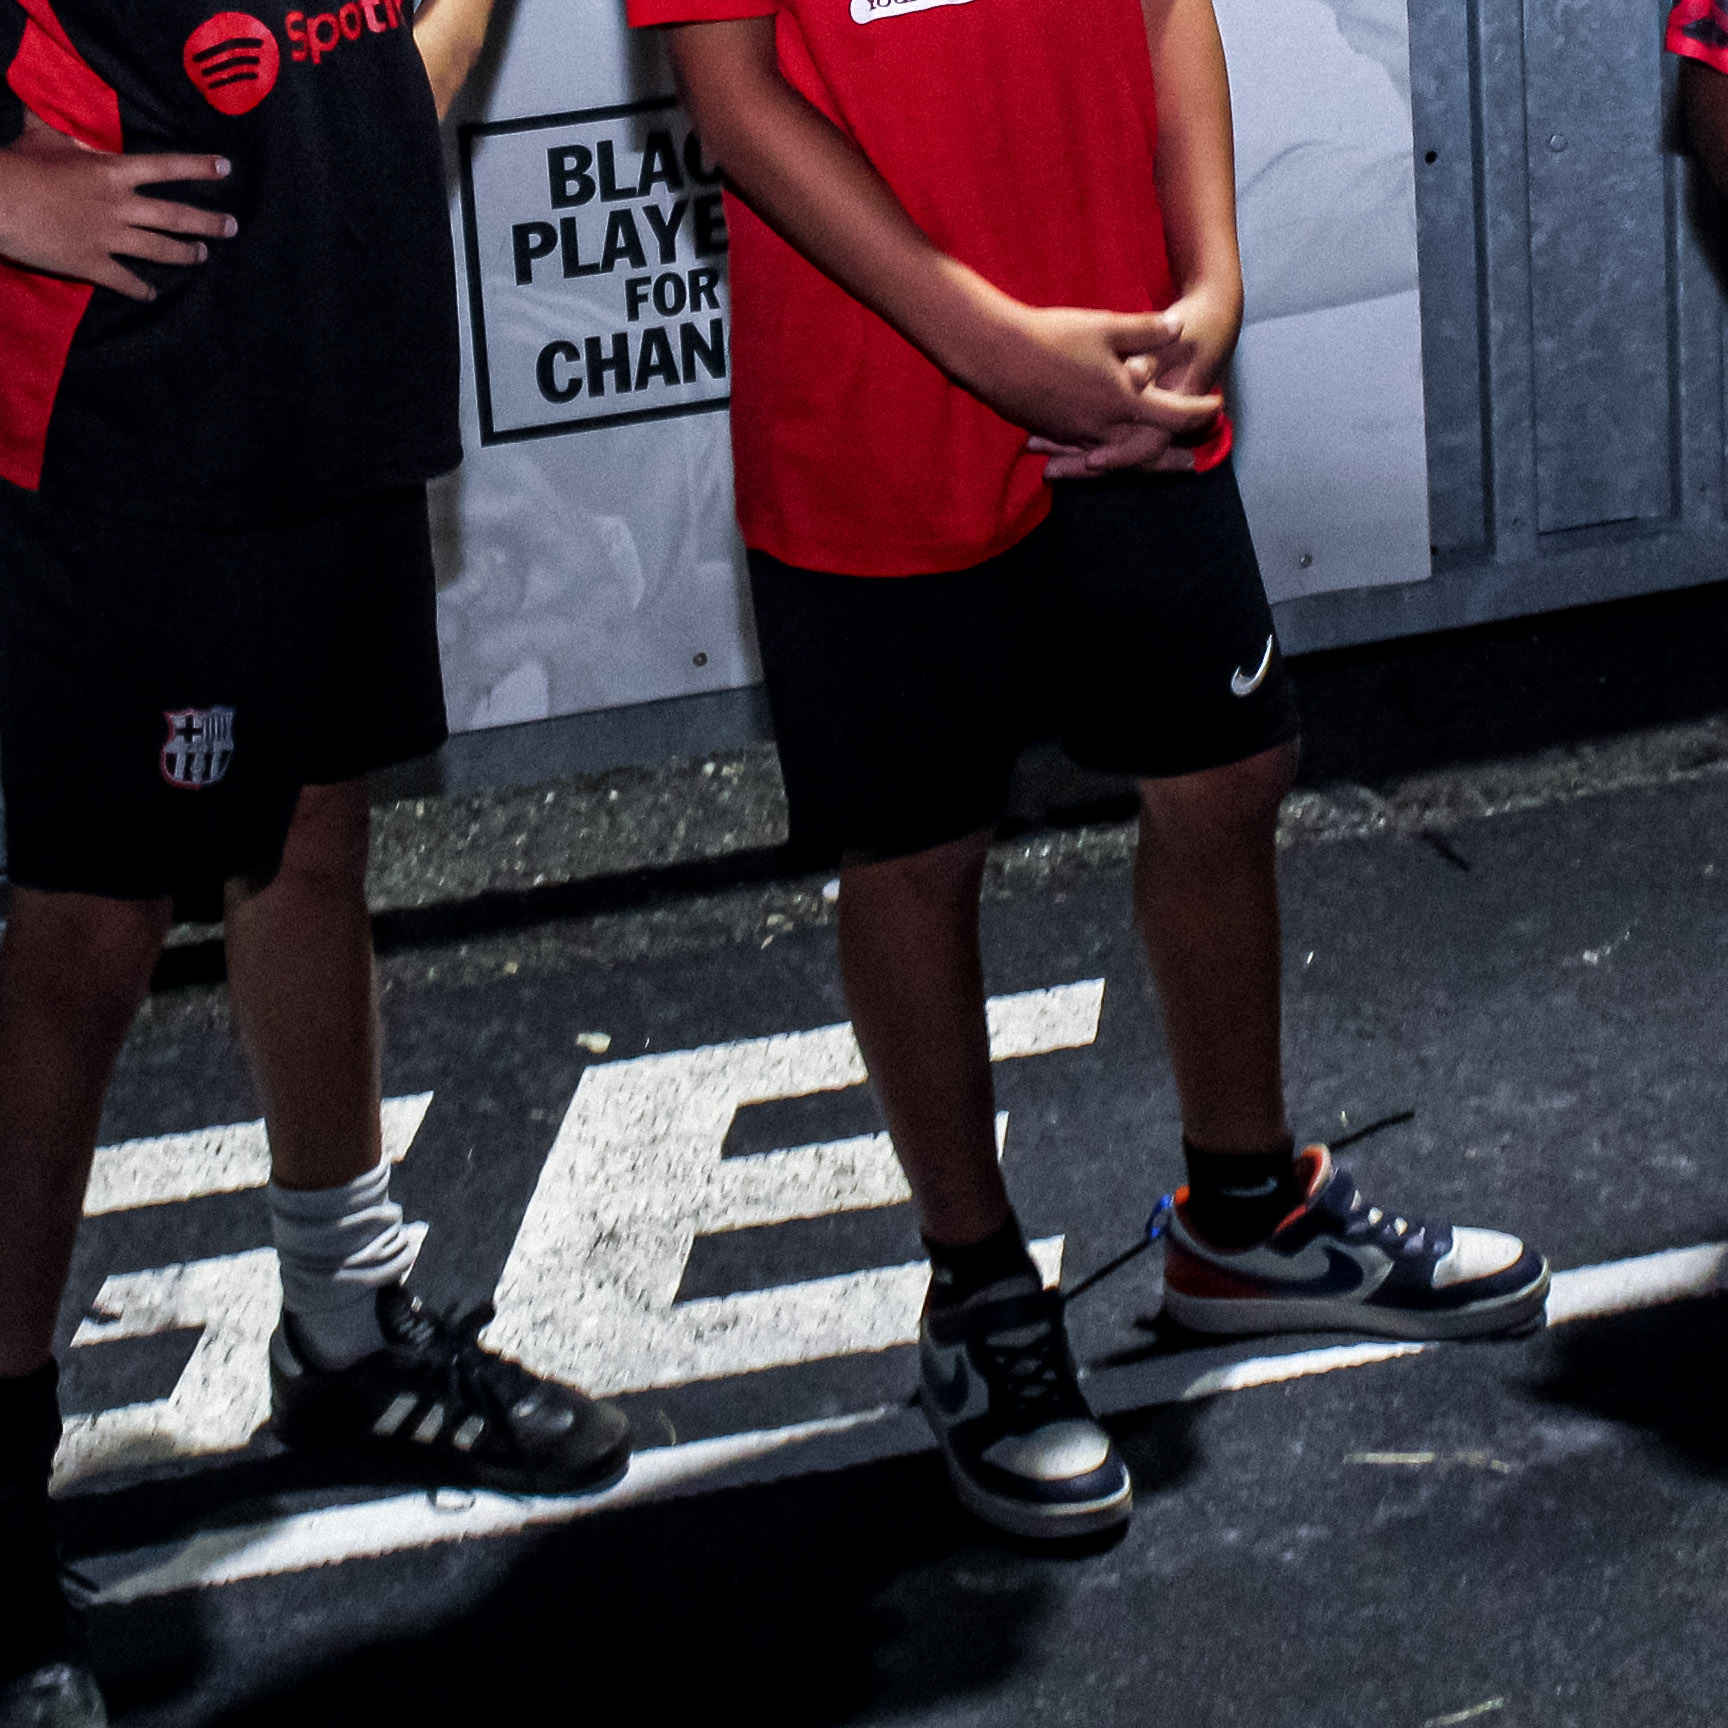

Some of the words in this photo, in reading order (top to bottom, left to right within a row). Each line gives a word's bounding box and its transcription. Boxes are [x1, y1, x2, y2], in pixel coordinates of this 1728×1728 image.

[511, 193, 729, 286] PLAYE
[624, 269, 720, 322] FOR
[535, 317, 727, 404] CHAN
